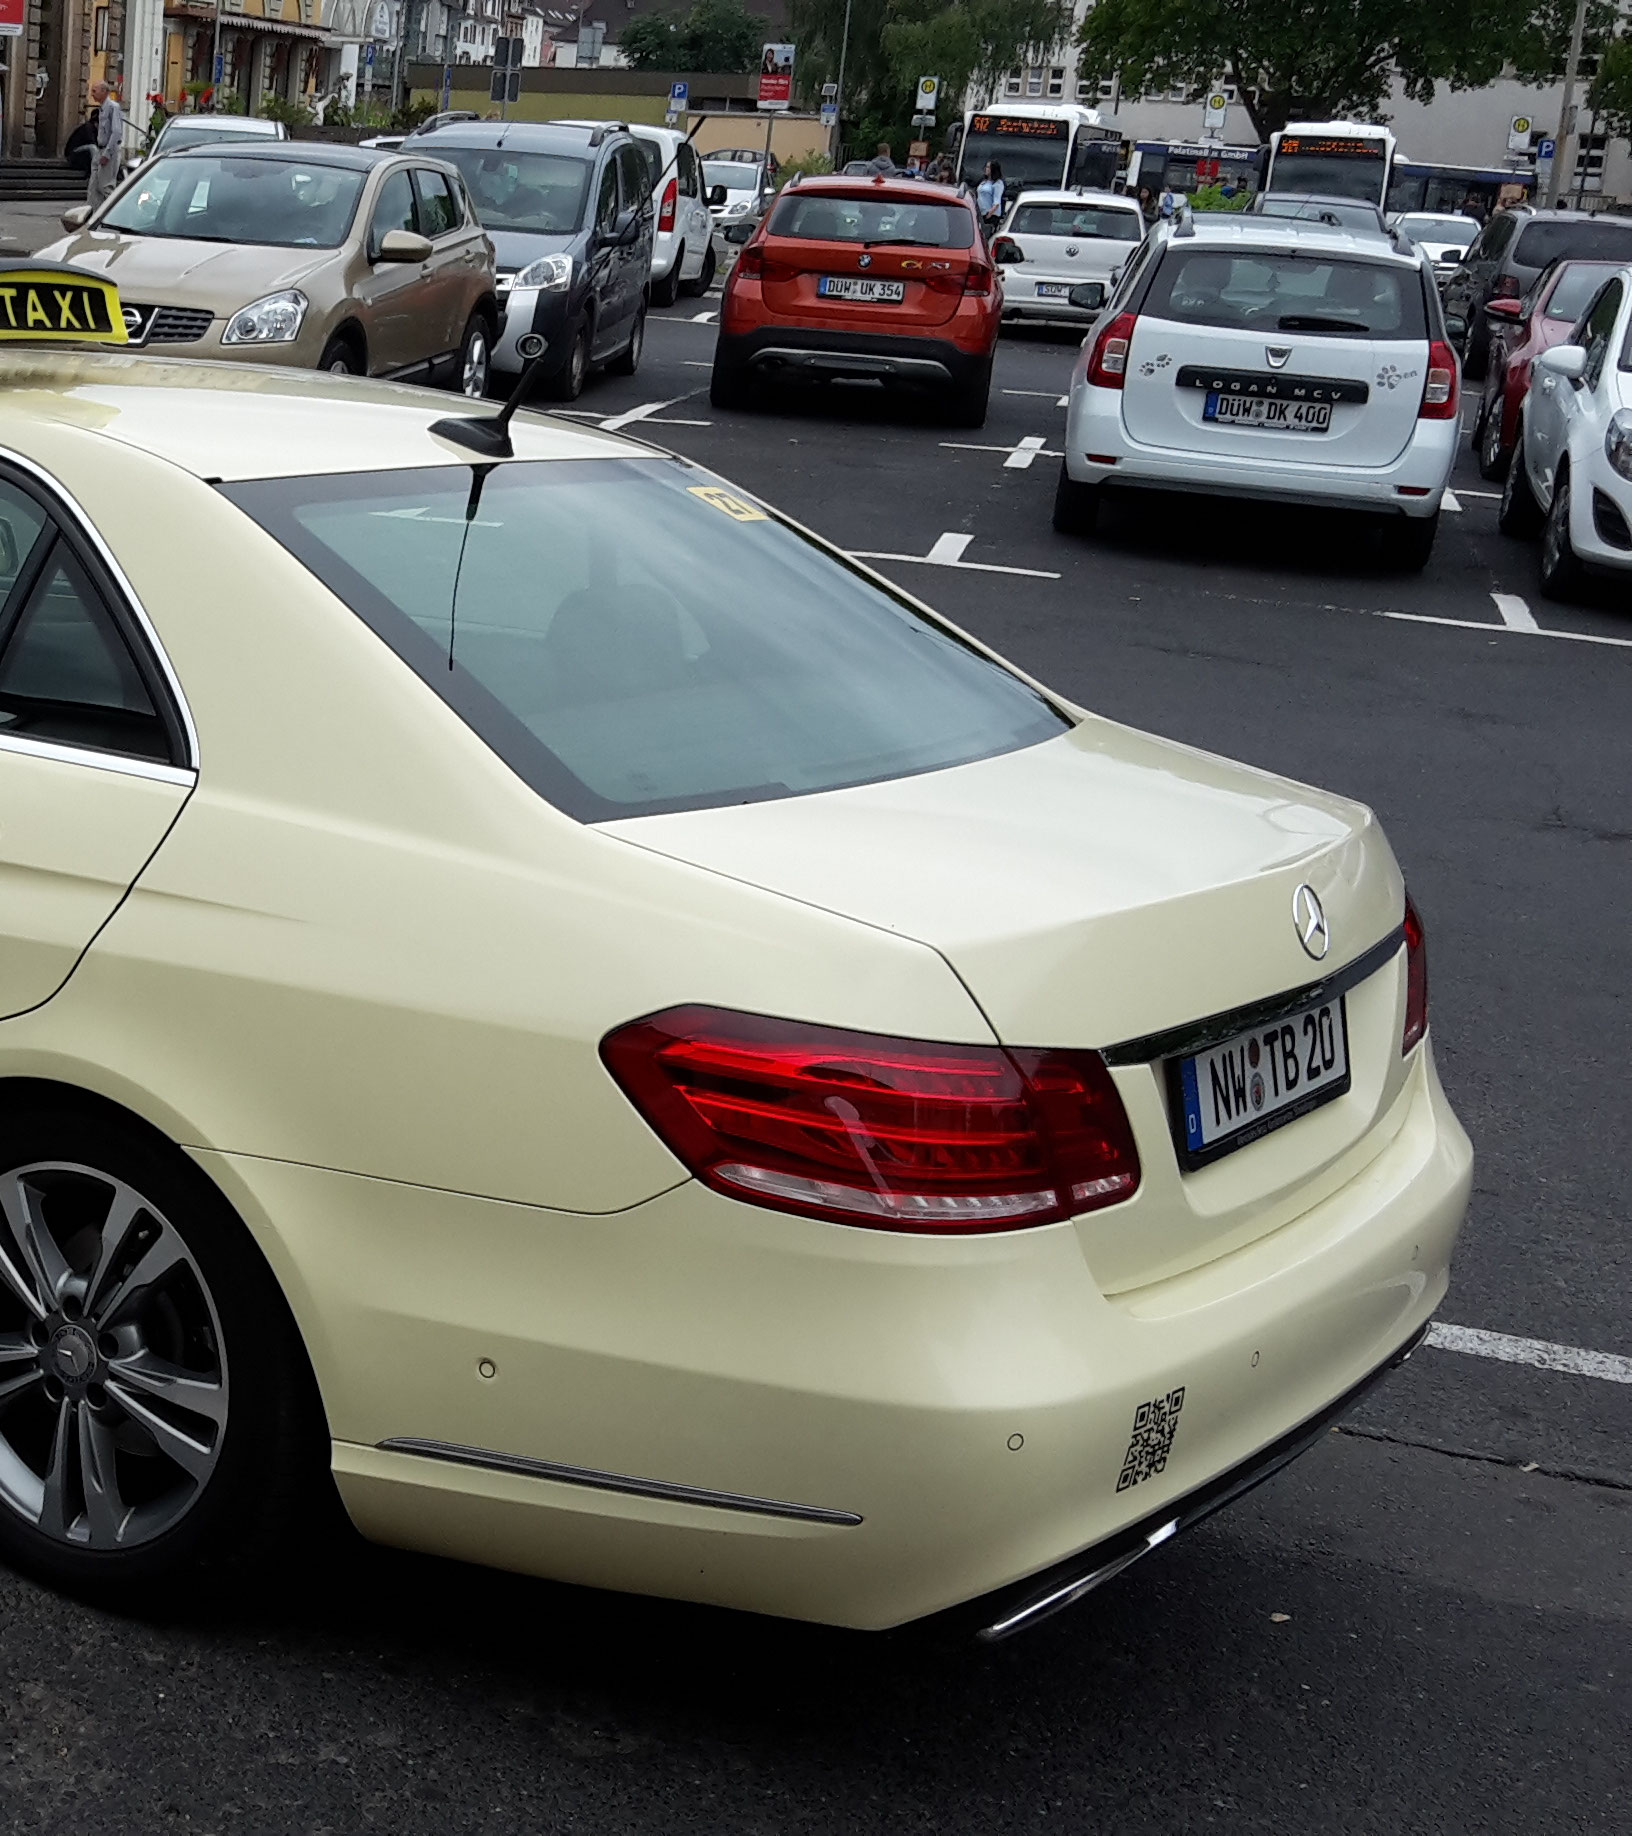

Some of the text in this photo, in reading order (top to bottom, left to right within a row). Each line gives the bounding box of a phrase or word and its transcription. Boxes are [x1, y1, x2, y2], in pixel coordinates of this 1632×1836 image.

[1541, 141, 1553, 156] P
[827, 279, 901, 298] DÜW UK 354
[1195, 378, 1342, 400] LOGAN MCV
[1218, 397, 1253, 418] DÜW
[1267, 402, 1288, 422] DK
[1293, 404, 1328, 426] 400
[1209, 1045, 1247, 1127] NW
[1263, 1023, 1300, 1098] TB
[1303, 1006, 1335, 1081] 20
